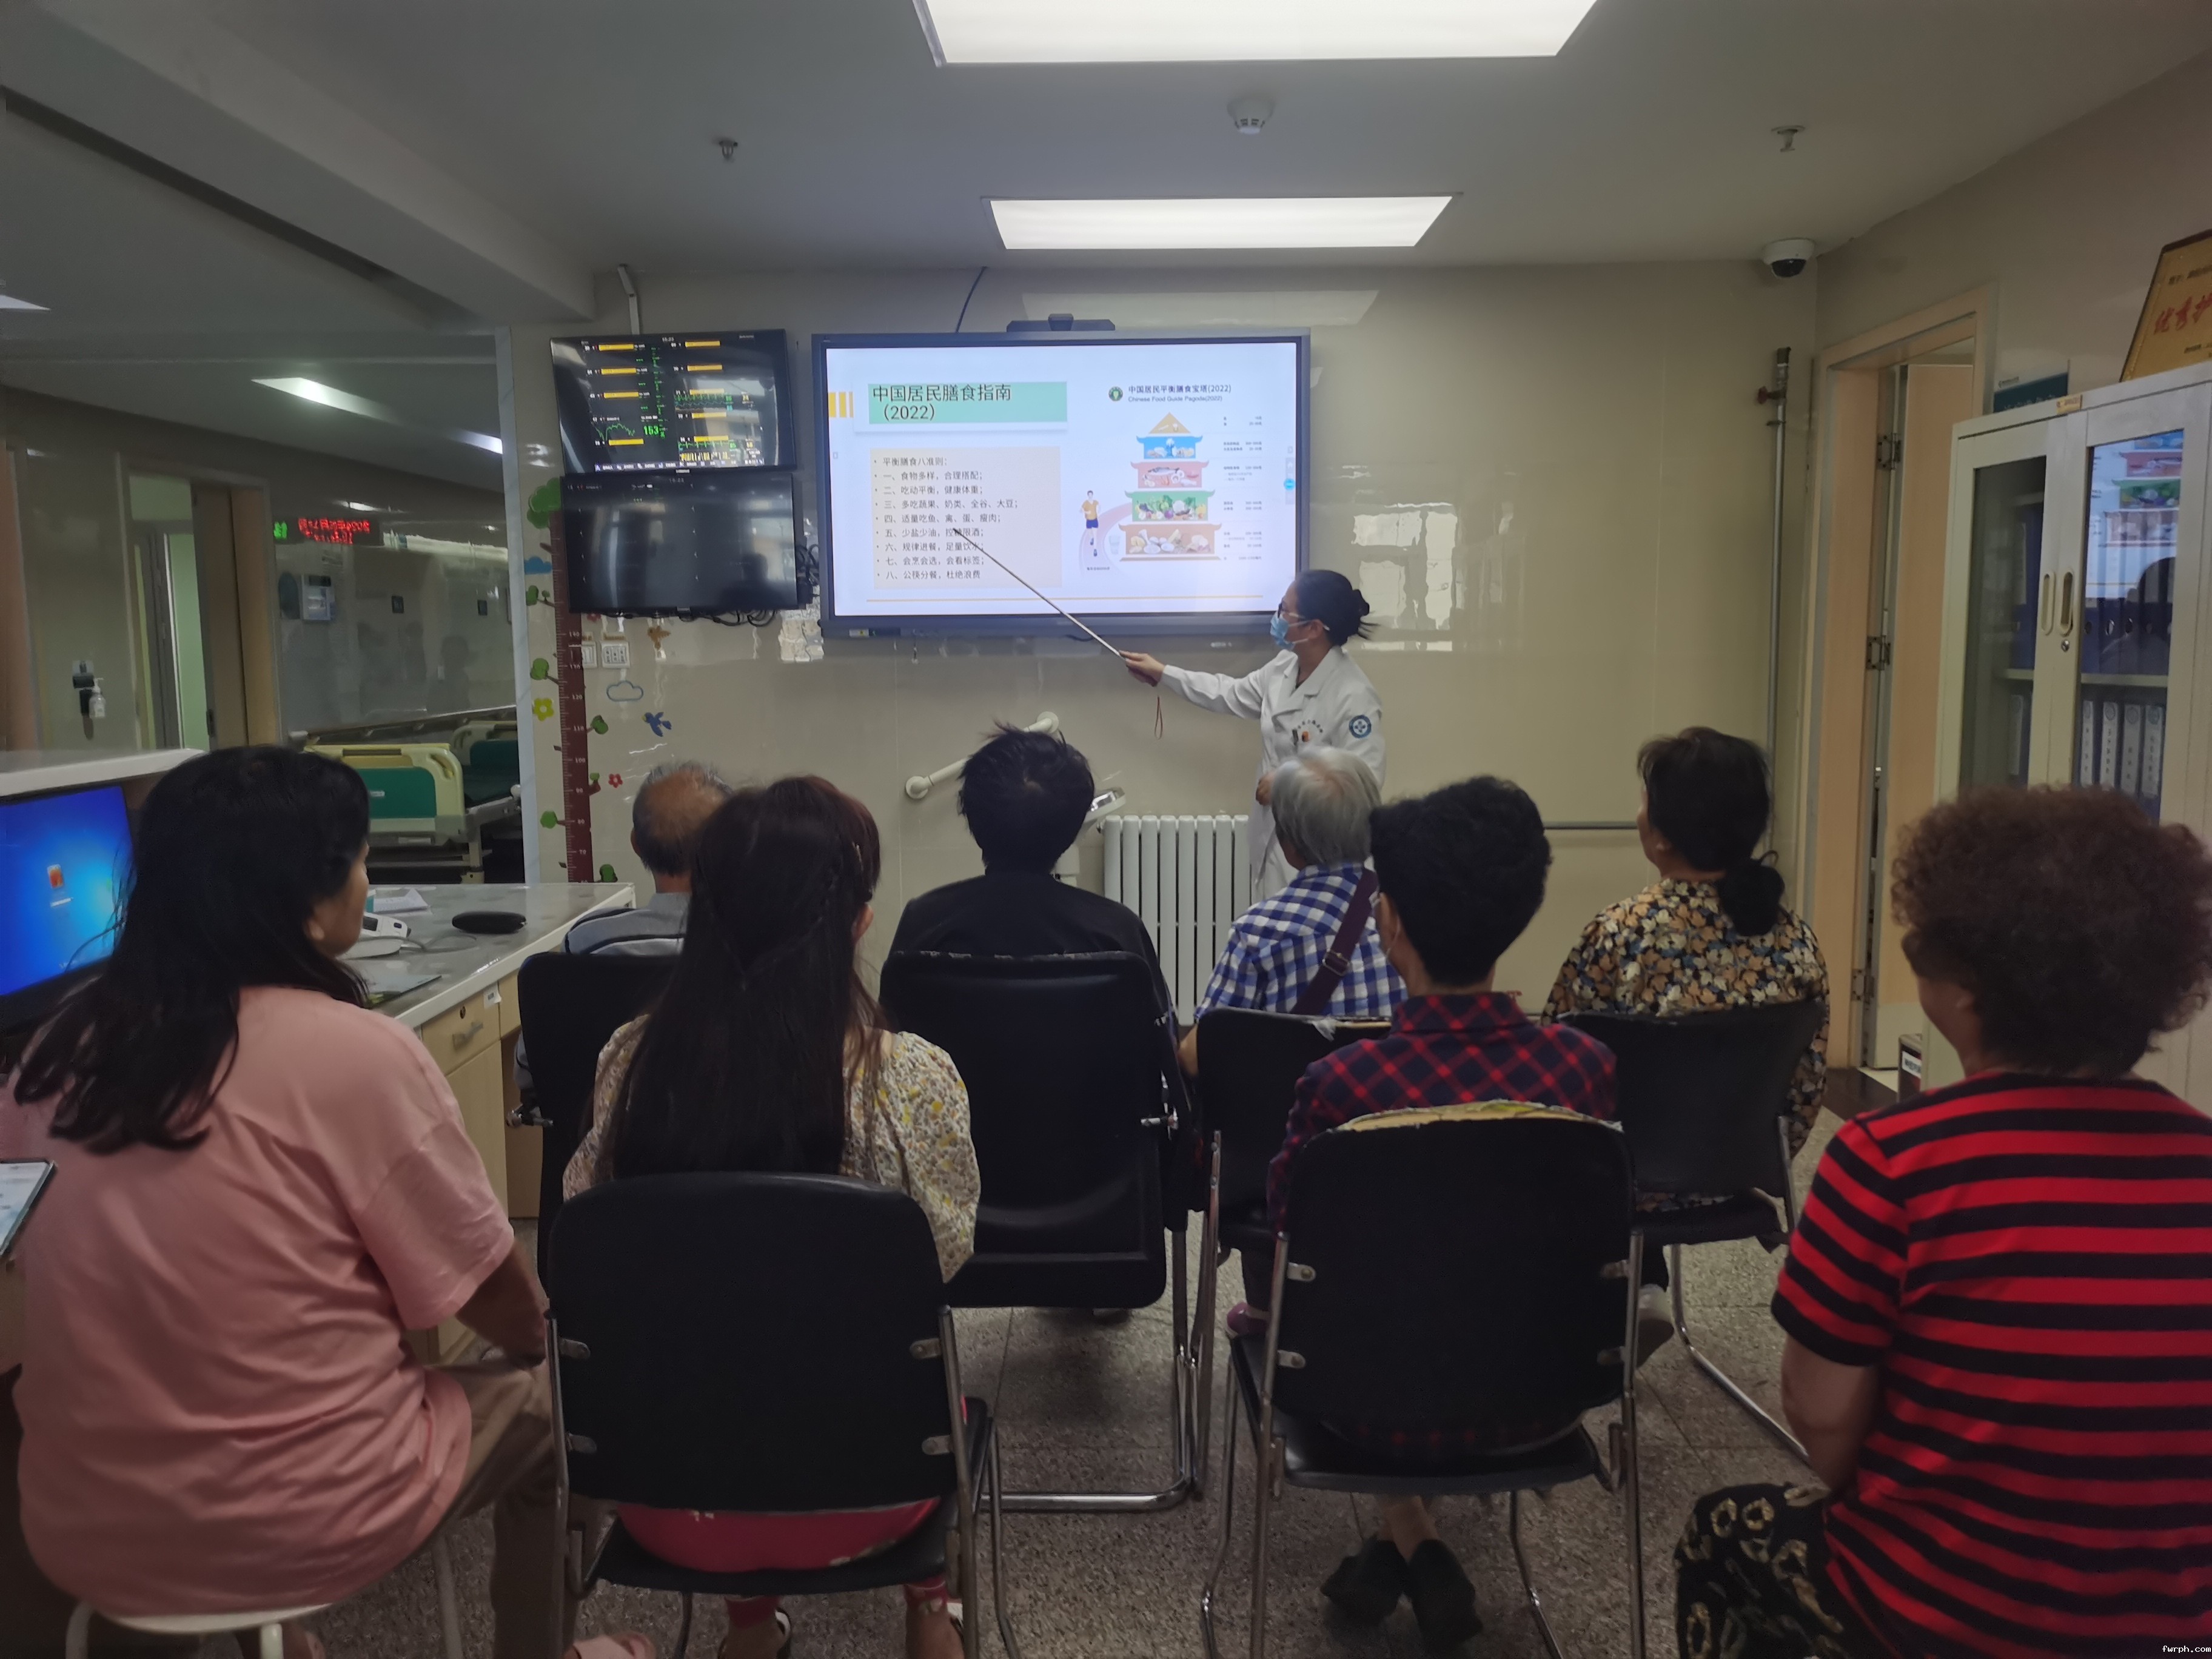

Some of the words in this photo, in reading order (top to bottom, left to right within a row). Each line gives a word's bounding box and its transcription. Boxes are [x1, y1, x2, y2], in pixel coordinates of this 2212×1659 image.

[873, 384, 1011, 403] 中国居民膳食指南
